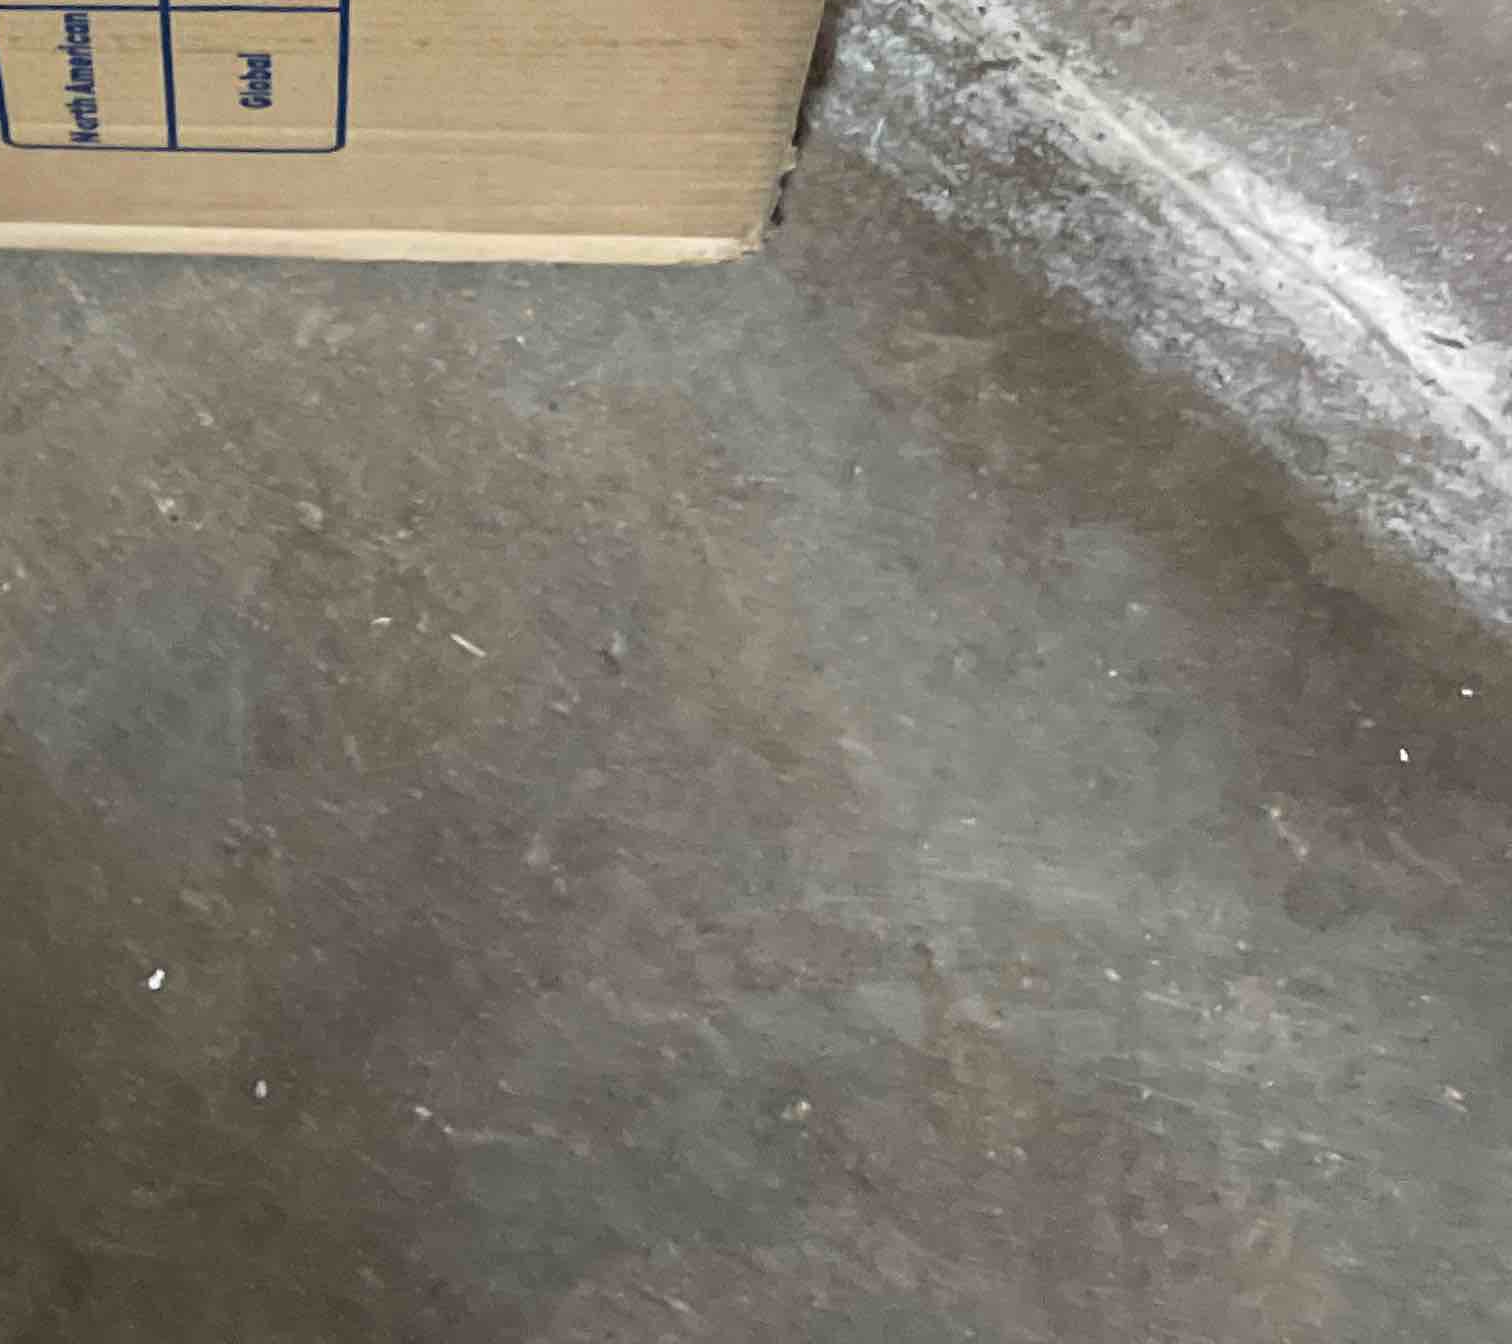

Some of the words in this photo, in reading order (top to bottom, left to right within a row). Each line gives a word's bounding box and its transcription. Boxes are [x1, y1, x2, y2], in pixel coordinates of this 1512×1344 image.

[56, 12, 96, 95] American
[237, 52, 273, 110] Global
[67, 96, 101, 144] North
